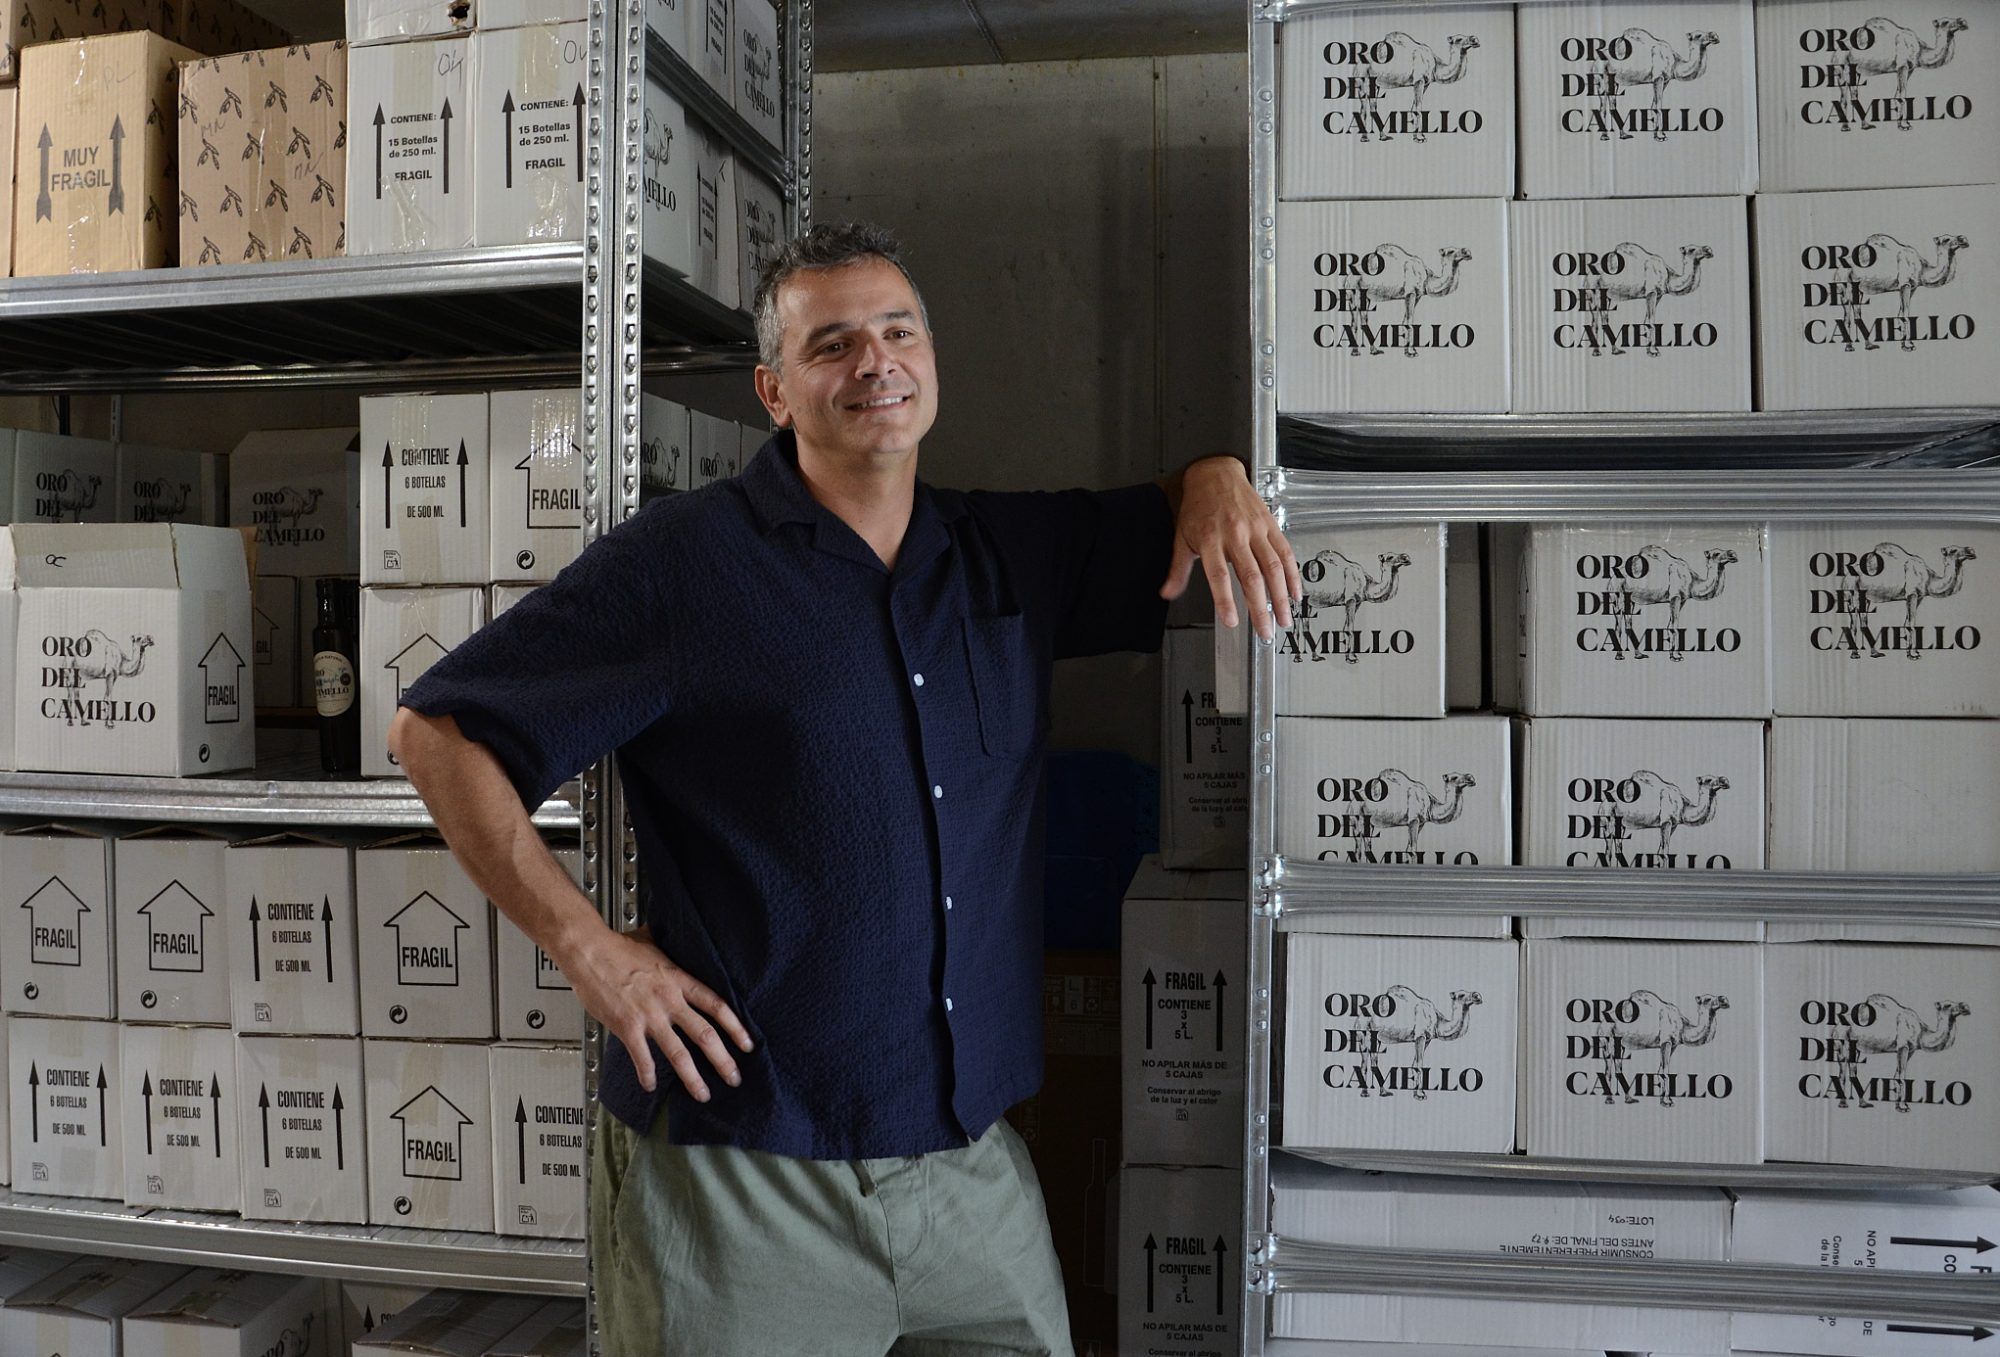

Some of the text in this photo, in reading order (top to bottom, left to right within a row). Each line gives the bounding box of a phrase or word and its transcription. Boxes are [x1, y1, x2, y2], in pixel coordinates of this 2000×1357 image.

[1560, 37, 1633, 61] ORO
[1800, 26, 1875, 52] ORO
[1323, 41, 1394, 65] ORO
[1561, 73, 1625, 97] DEL
[1800, 63, 1867, 88] DEL
[1323, 76, 1386, 99] DEL
[520, 100, 569, 112] CONTIENE:
[1801, 94, 1972, 124] CAMELLO
[391, 113, 437, 125] CONTIENE:
[519, 122, 571, 134] 15 Botellas
[1323, 110, 1483, 134] CAMELLO
[1561, 107, 1724, 132] CAMELLO
[388, 136, 438, 147] 15 Botellas
[519, 134, 569, 146] de 250 ml.
[63, 146, 99, 168] MUY
[389, 146, 436, 159] de 250 ml.
[525, 158, 566, 169] FRAGIL
[51, 169, 111, 192] FRAGIL
[395, 170, 432, 181] FRAGIL
[1314, 252, 1385, 276] ORO
[1552, 252, 1626, 276] ORO
[1802, 244, 1877, 270] ORO
[1314, 288, 1377, 312] DEL
[1553, 288, 1617, 312] DEL
[1803, 281, 1870, 307] DEL
[1313, 323, 1475, 348] CAMELLO
[1553, 322, 1718, 348] CAMELLO
[1804, 313, 1975, 344] CAMELLO
[401, 447, 449, 467] CONTIENE
[700, 456, 718, 478] ORO
[36, 472, 67, 492] ORO
[134, 481, 161, 499] ORO
[405, 476, 446, 488] 6 BOTELLAS
[36, 498, 64, 518] DEL
[532, 488, 581, 510] FRAGIL
[407, 505, 444, 518] DE 500 ML
[1576, 554, 1649, 579] ORO
[1809, 552, 1885, 577] ORO
[1576, 591, 1642, 615] DEL
[1810, 589, 1877, 613] DEL
[42, 636, 92, 658] ORO
[1276, 629, 1415, 654] AMELLO
[1576, 627, 1741, 652] CAMELLO
[1810, 625, 1981, 650] CAMELLO
[42, 667, 86, 688] DEL
[208, 686, 236, 706] FRAGIL
[41, 698, 156, 723] CAMELLO
[1195, 717, 1243, 726] CONTIENE
[1317, 778, 1389, 802] ORO
[1568, 778, 1641, 803] ORO
[1318, 814, 1380, 838] DEL
[1567, 814, 1632, 839] DEL
[268, 903, 314, 920] CONTIENE
[35, 927, 76, 949] FRAGIL
[153, 933, 198, 954] FRAGIL
[272, 931, 312, 943] 6 BOTELLAS
[275, 960, 311, 972] DE 500 ML
[402, 946, 453, 968] FRAGIL
[1165, 972, 1206, 990] FRAGIL
[1158, 999, 1211, 1010] CONTIENE
[1181, 1010, 1187, 1020] 3
[1325, 993, 1396, 1018] ORO
[1566, 998, 1640, 1024] ORO
[1800, 1000, 1876, 1027] ORO
[1175, 1030, 1193, 1039] 5 L.
[1324, 1028, 1387, 1053] DEL
[1566, 1035, 1632, 1060] DEL
[1800, 1037, 1867, 1064] DEL
[1142, 1060, 1155, 1068] NO
[1157, 1060, 1190, 1069] APILAR
[1214, 1061, 1227, 1070] DE
[1165, 1070, 1203, 1079] 5 CAJAS
[46, 1069, 90, 1087] CONTIENE
[159, 1079, 203, 1097] CONTIENE
[1323, 1064, 1483, 1092] CAMELLO
[1566, 1071, 1733, 1099] CAMELLO
[277, 1090, 324, 1108] CONTIENE
[1147, 1087, 1221, 1099] Conservar al abrigo
[1150, 1096, 1160, 1104] de
[1162, 1096, 1169, 1104] la
[1798, 1073, 1972, 1106] CAMELLO
[50, 1096, 87, 1108] 6 BOTELLAS
[163, 1106, 201, 1119] 6 BOTELLAS
[53, 1123, 86, 1136] DE 500 ML
[282, 1118, 322, 1131] 6 BOTELLAS
[167, 1134, 200, 1147] DE 500 ML
[407, 1139, 456, 1162] FRAGIL
[539, 1134, 582, 1148] 6 BOTELLAS
[285, 1146, 322, 1159] DE 500 ML
[542, 1163, 581, 1177] DE 500 ML
[1166, 1237, 1206, 1255] FRAGIL
[1570, 1236, 1598, 1246] FINAL
[1600, 1237, 1619, 1247] DEL
[1621, 1238, 1654, 1247] ANTES
[1601, 1249, 1653, 1259] CONSUMIR
[1159, 1264, 1211, 1275] CONTIENE
[1143, 1322, 1157, 1331] NO
[1158, 1323, 1191, 1332] APILAR
[1215, 1324, 1228, 1332] DE
